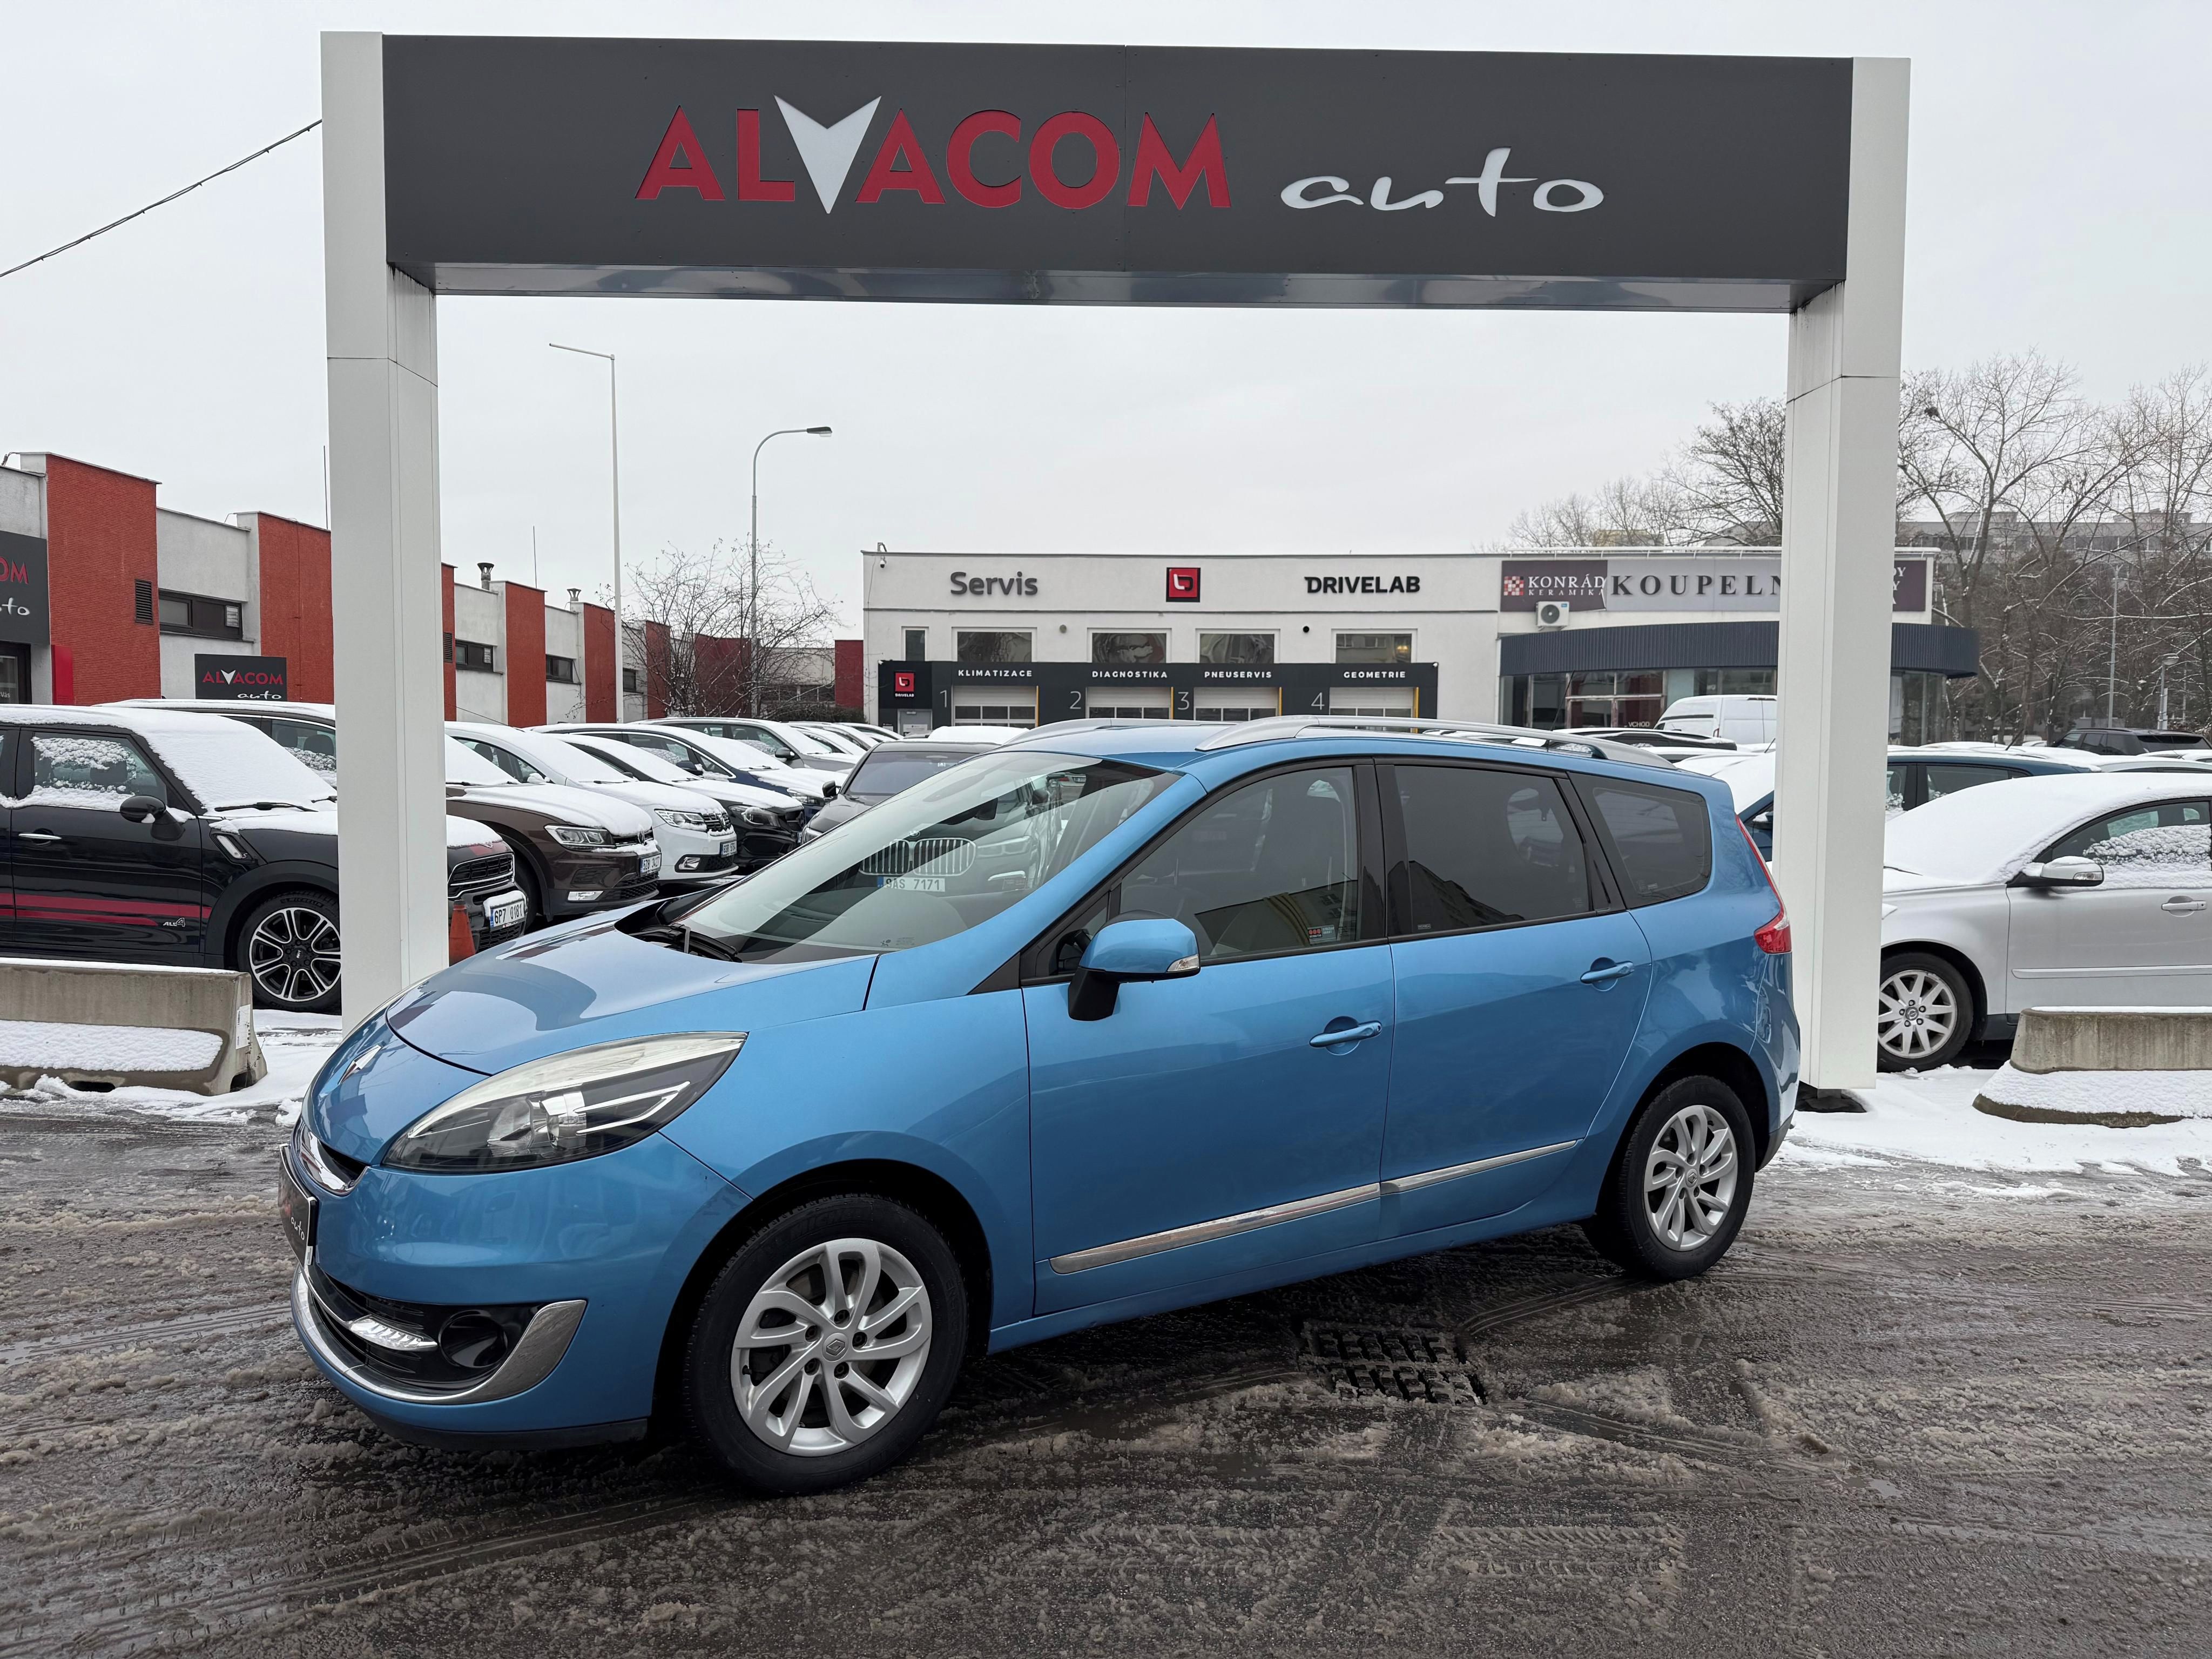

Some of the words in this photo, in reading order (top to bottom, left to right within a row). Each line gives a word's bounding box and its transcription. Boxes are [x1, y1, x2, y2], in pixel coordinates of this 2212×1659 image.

[636, 96, 1232, 214] ALVACOM
[1280, 148, 1605, 218] auto
[950, 571, 1039, 597] Servis
[1304, 576, 1421, 594] DRIVELAB
[1528, 573, 1603, 589] KONRÁD
[202, 669, 284, 685] ALVACOM
[1092, 671, 1168, 679] DIAGNOSTIKA
[1343, 671, 1407, 679] GEOMETRIE
[237, 690, 282, 700] auto
[940, 690, 947, 708] 1
[1069, 691, 1082, 710] 2
[1177, 691, 1190, 711] 3
[1311, 692, 1325, 711] 4
[914, 879, 940, 891] 7171
[494, 908, 507, 925] 6P7
[510, 902, 523, 920] 0181
[291, 1216, 306, 1241] auto
